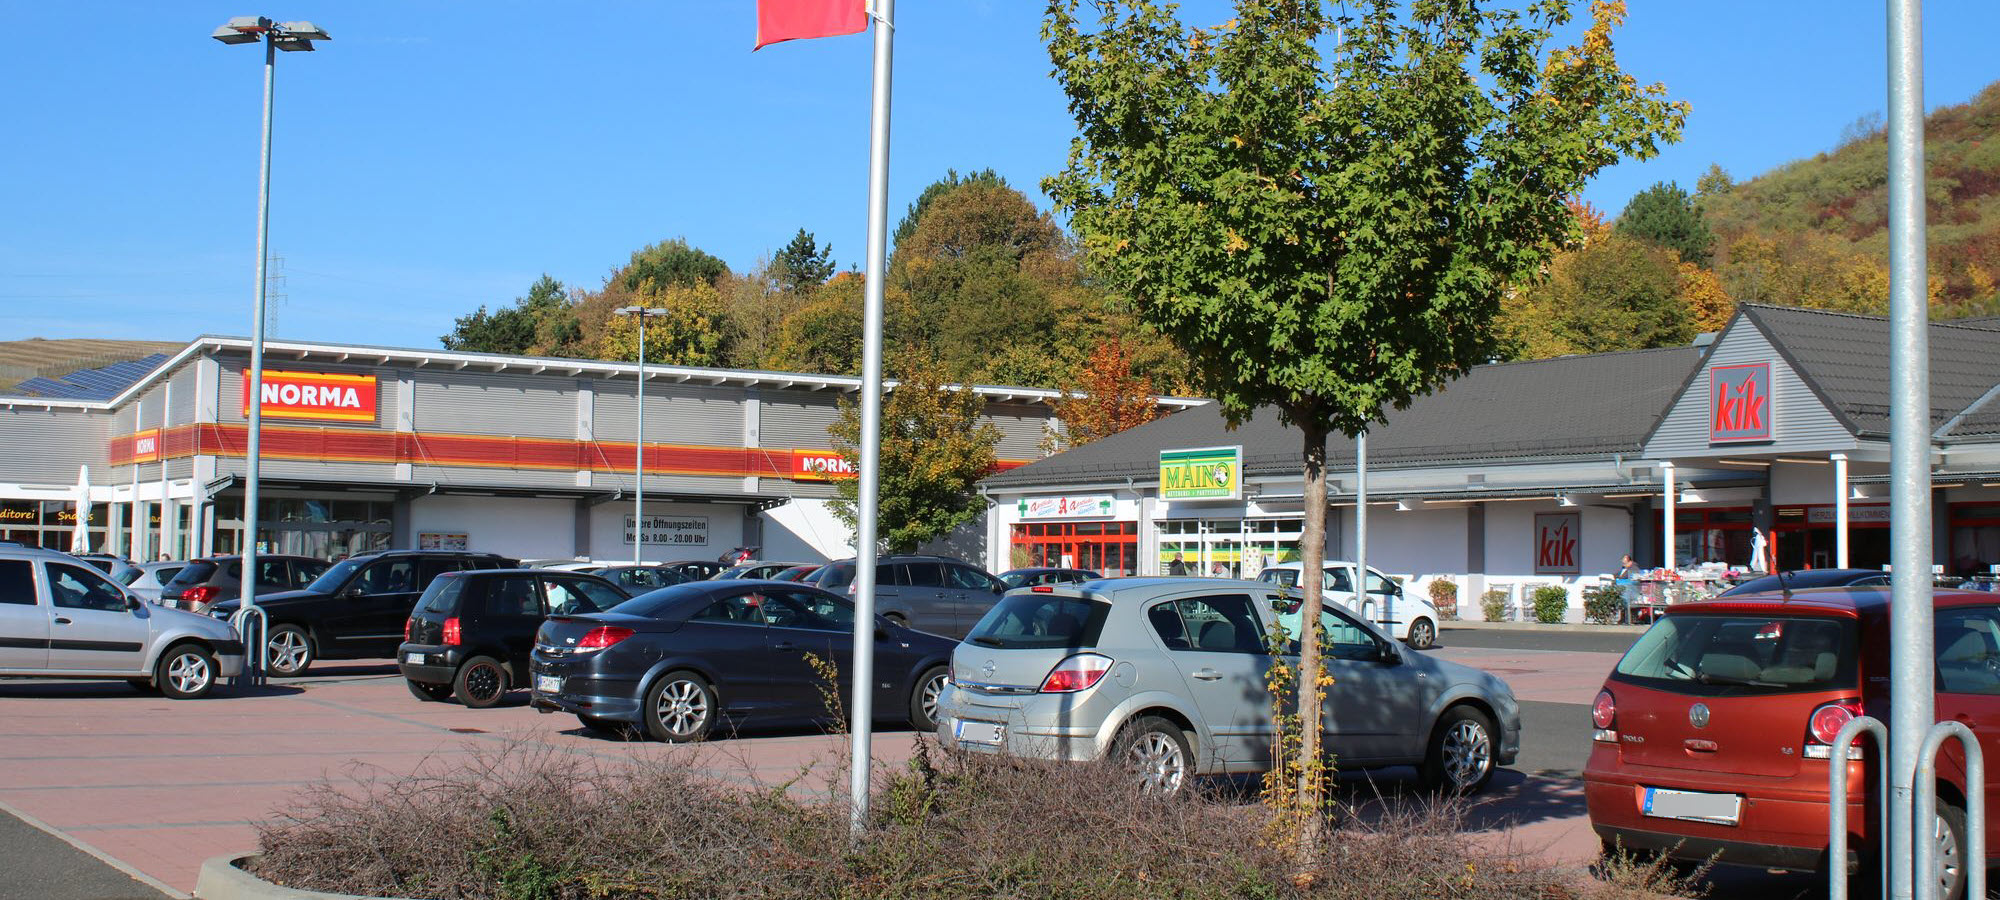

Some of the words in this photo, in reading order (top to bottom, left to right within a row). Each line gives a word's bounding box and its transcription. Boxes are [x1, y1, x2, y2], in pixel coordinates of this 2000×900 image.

[261, 383, 360, 408] NORMA
[136, 438, 155, 454] NORMA
[58, 511, 94, 521] Snas
[626, 518, 651, 529] Unere
[653, 516, 706, 531] Öffnungszeiten
[653, 533, 668, 543] 8.00
[674, 534, 693, 543] 20.00
[695, 534, 706, 543] Uhr
[1622, 734, 1645, 743] POLO
